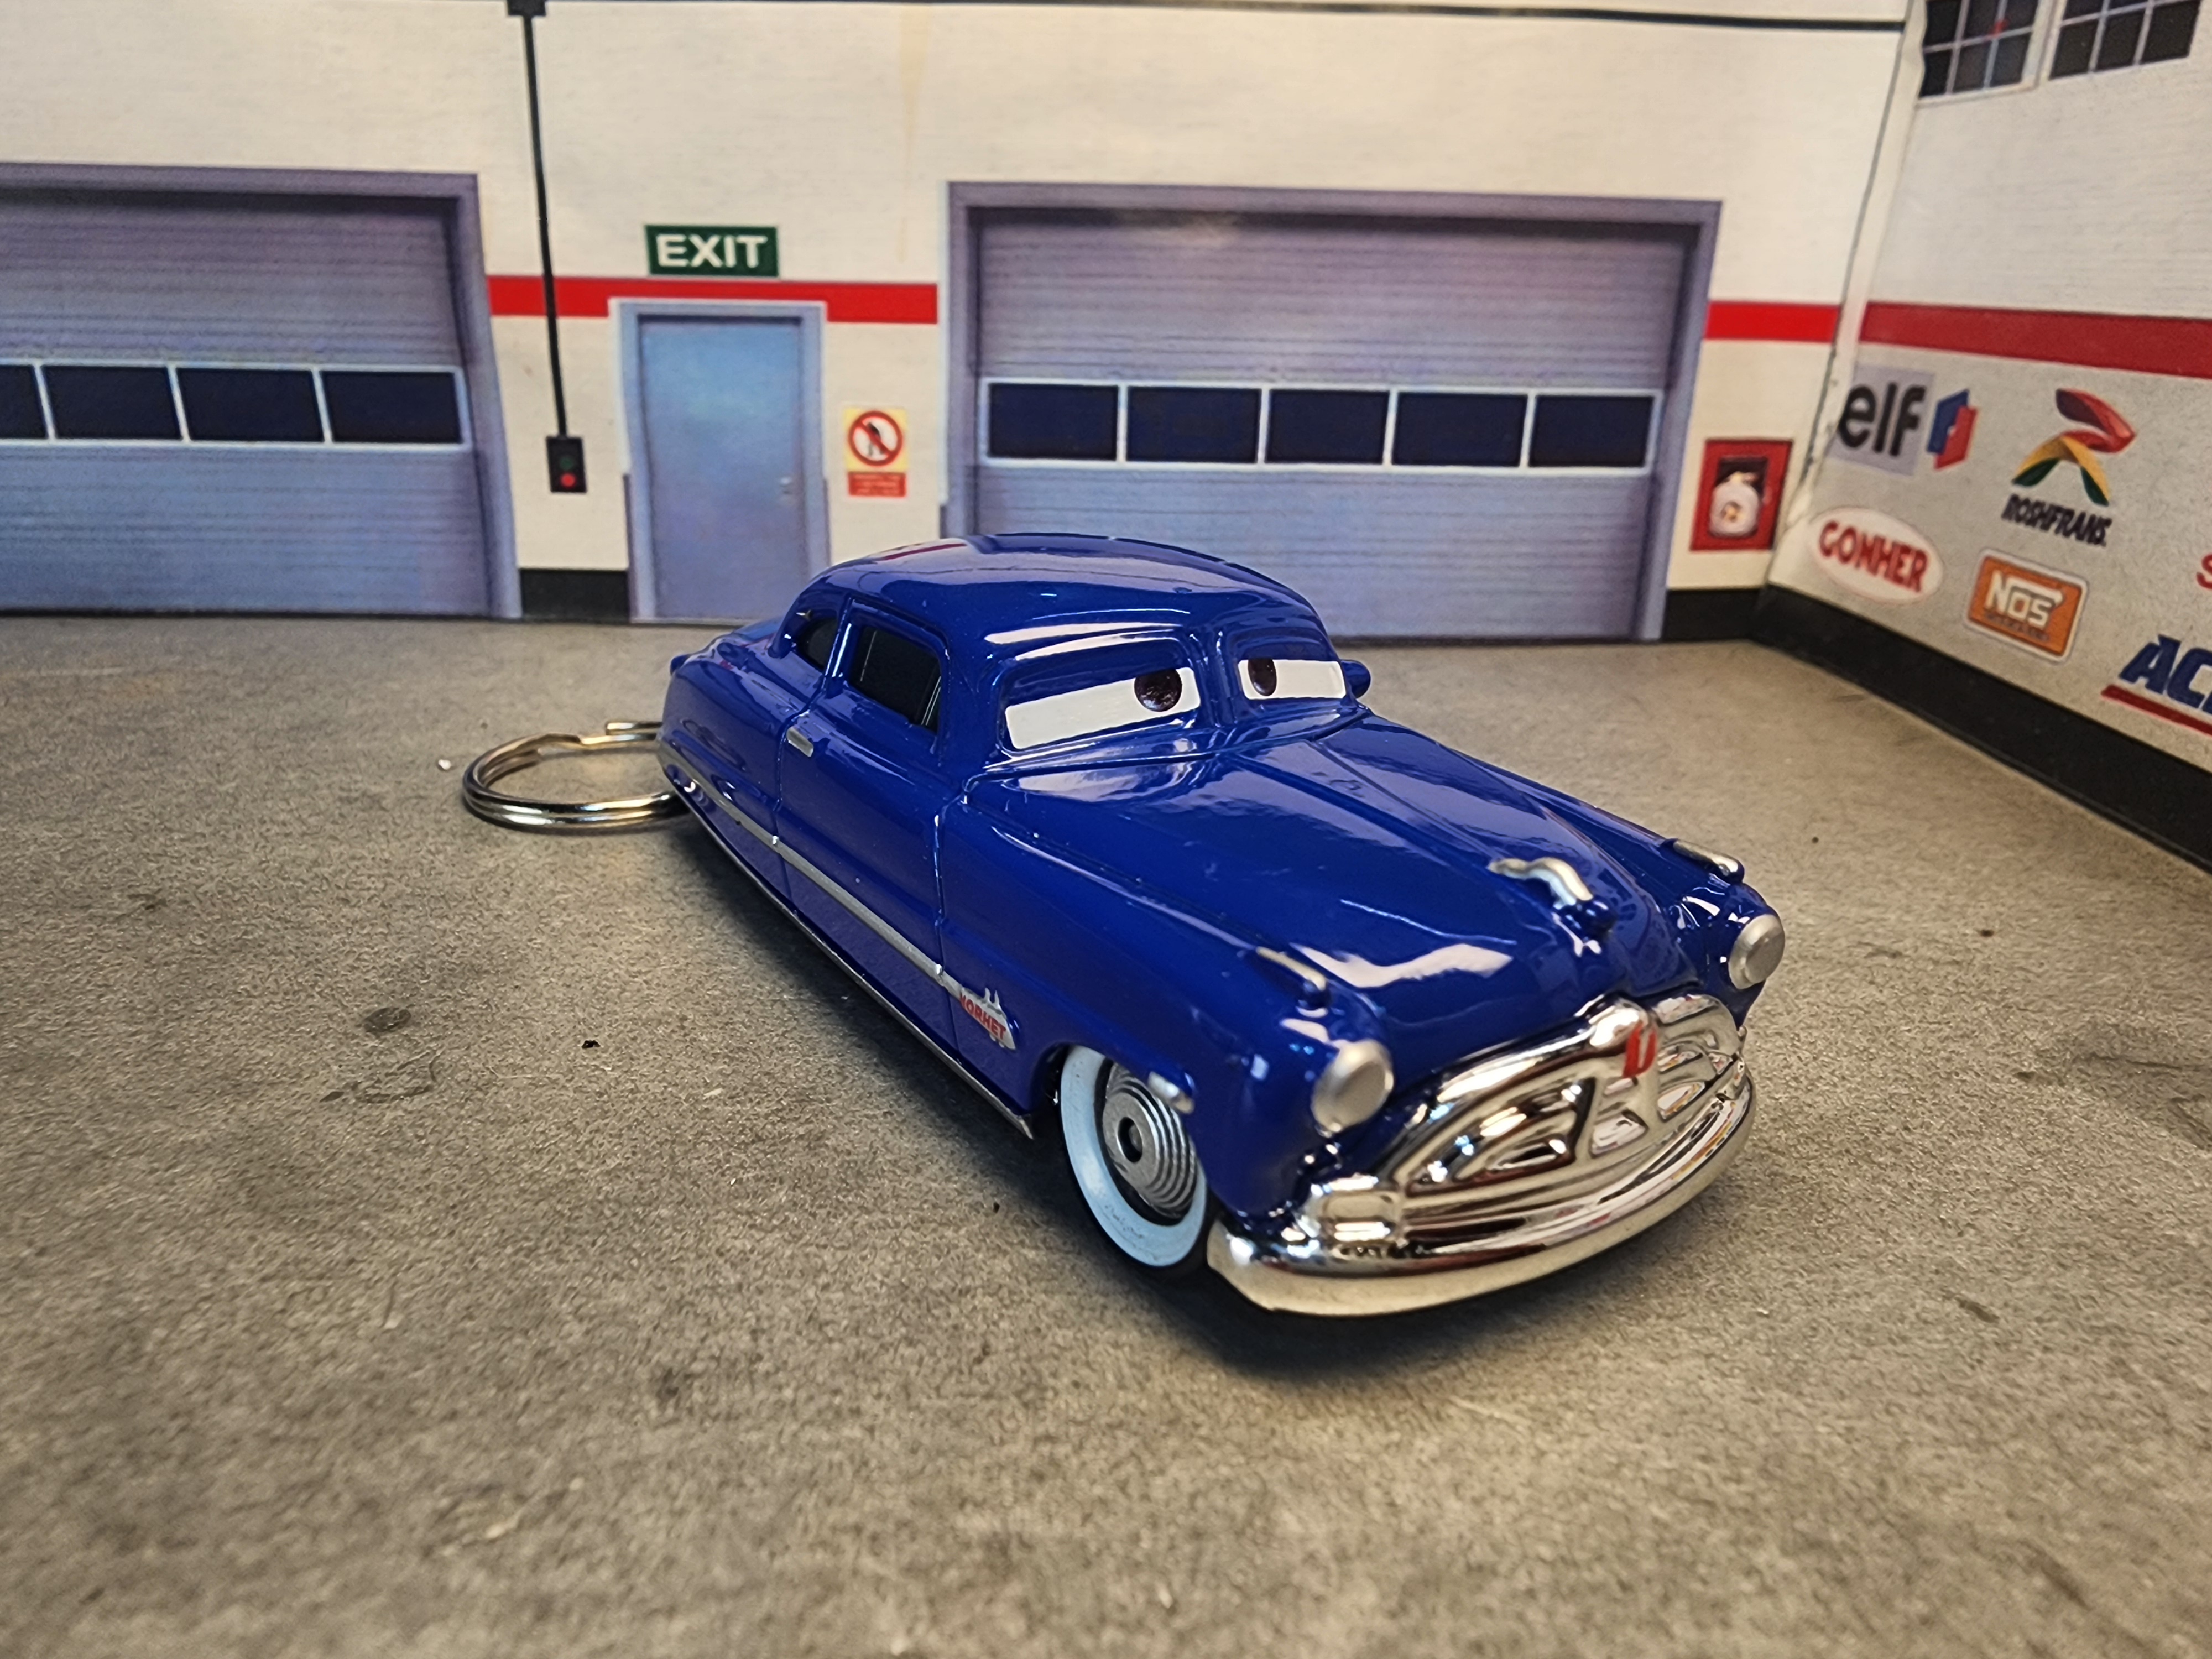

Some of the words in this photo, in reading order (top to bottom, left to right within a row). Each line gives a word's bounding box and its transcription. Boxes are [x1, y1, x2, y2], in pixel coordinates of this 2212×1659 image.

[656, 233, 768, 268] EXIT
[1838, 382, 1926, 457] elf
[1985, 570, 2063, 630] NOS
[2118, 634, 2212, 715] AC
